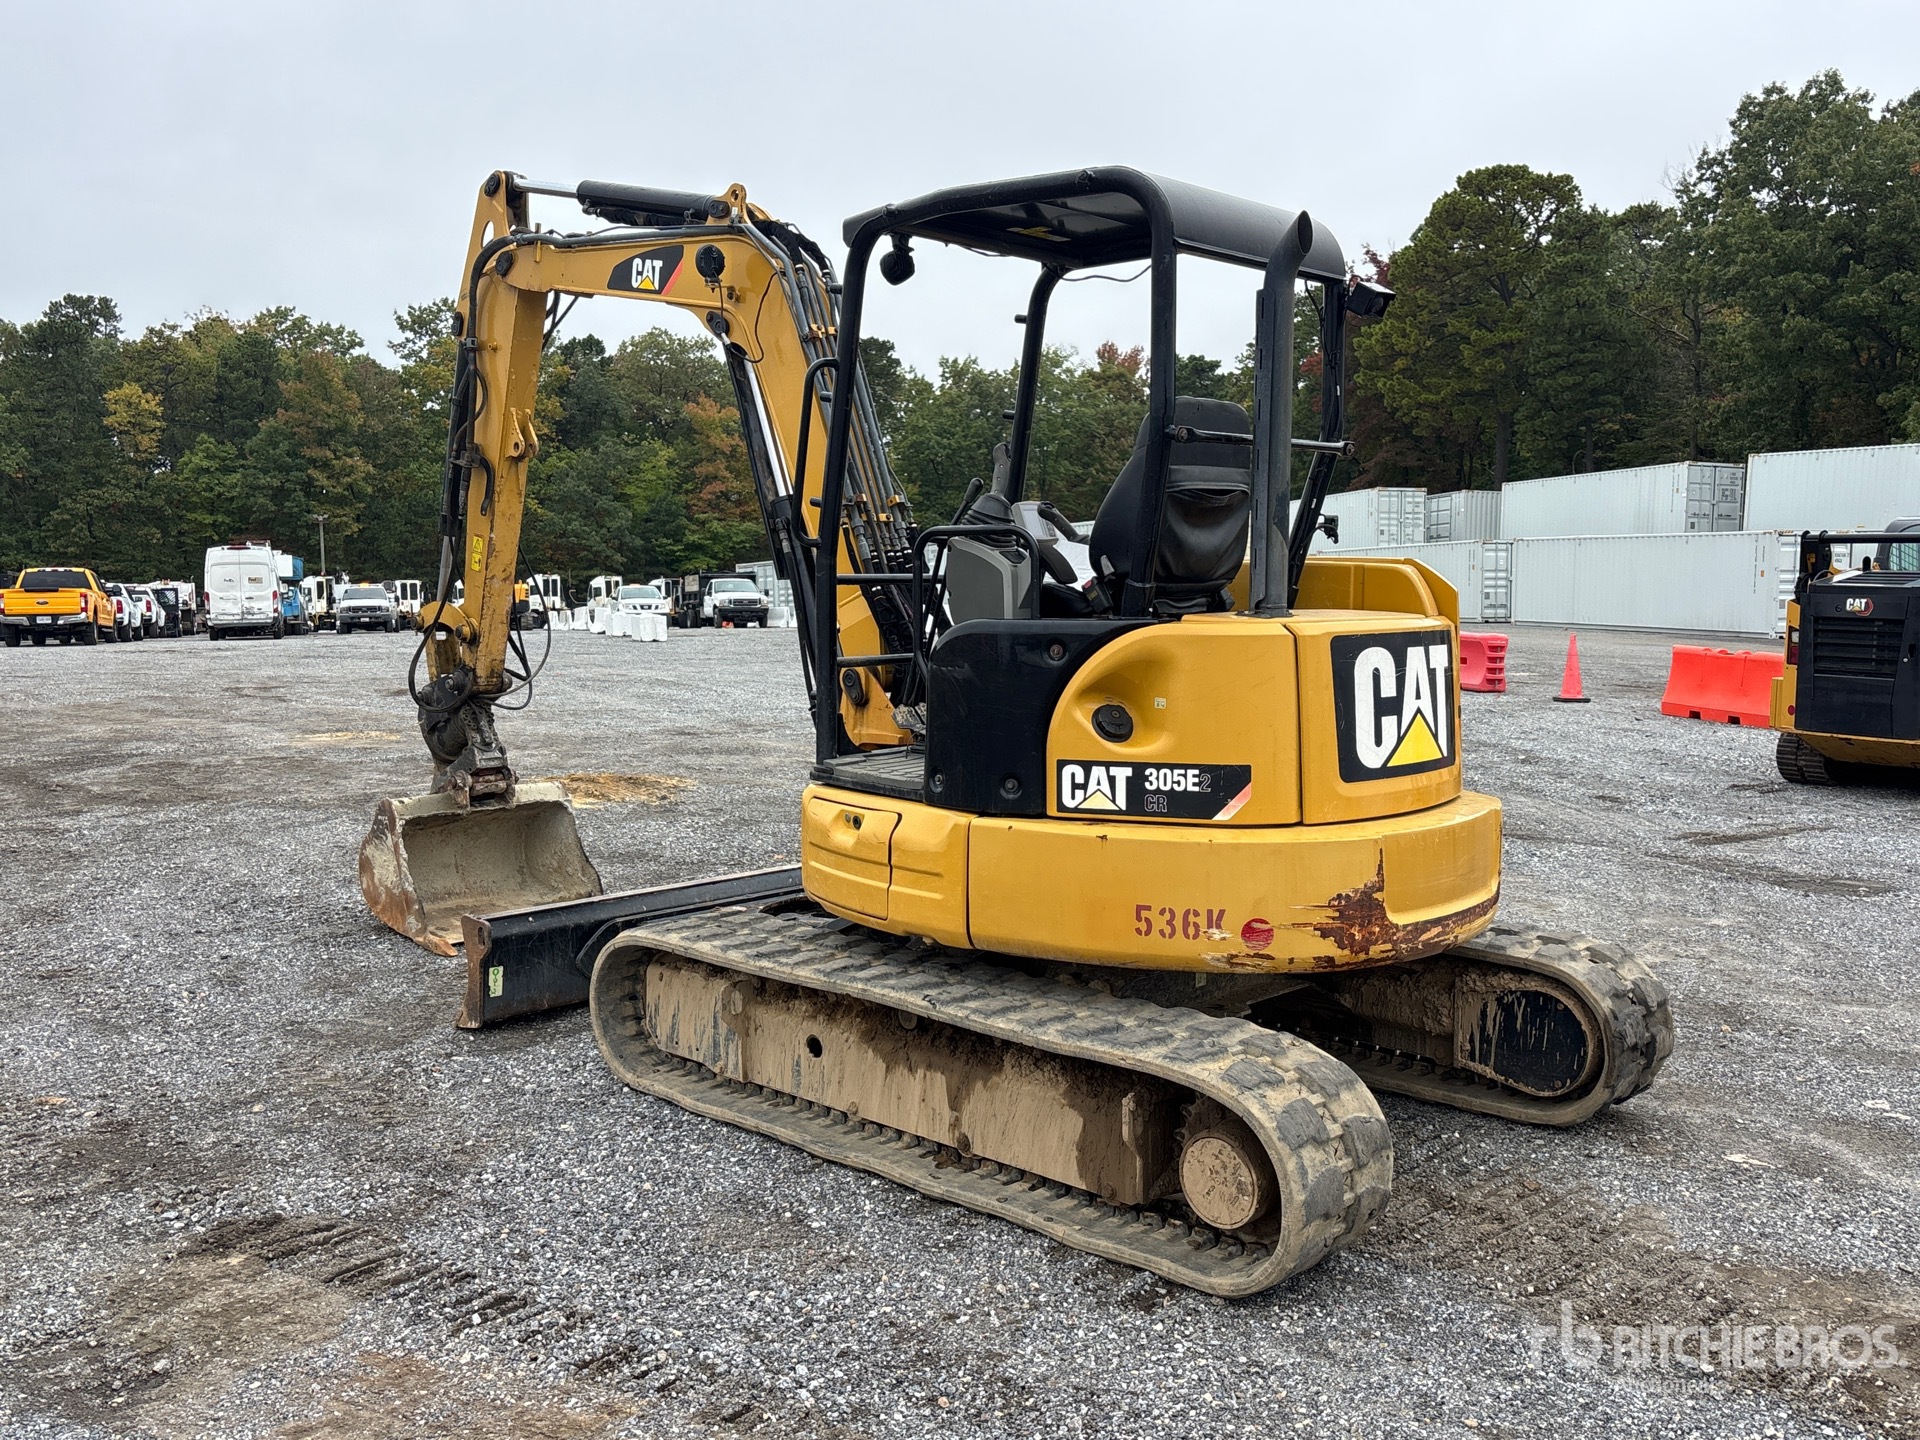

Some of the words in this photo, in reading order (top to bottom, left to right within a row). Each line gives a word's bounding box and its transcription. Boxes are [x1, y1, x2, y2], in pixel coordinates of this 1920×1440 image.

[632, 258, 663, 290] CAT
[1846, 598, 1868, 612] CAT
[1354, 644, 1449, 769] CAT
[1061, 764, 1133, 811] CAT
[1144, 767, 1212, 792] 305E2
[1144, 794, 1168, 812] CR
[1134, 904, 1227, 941] 536K
